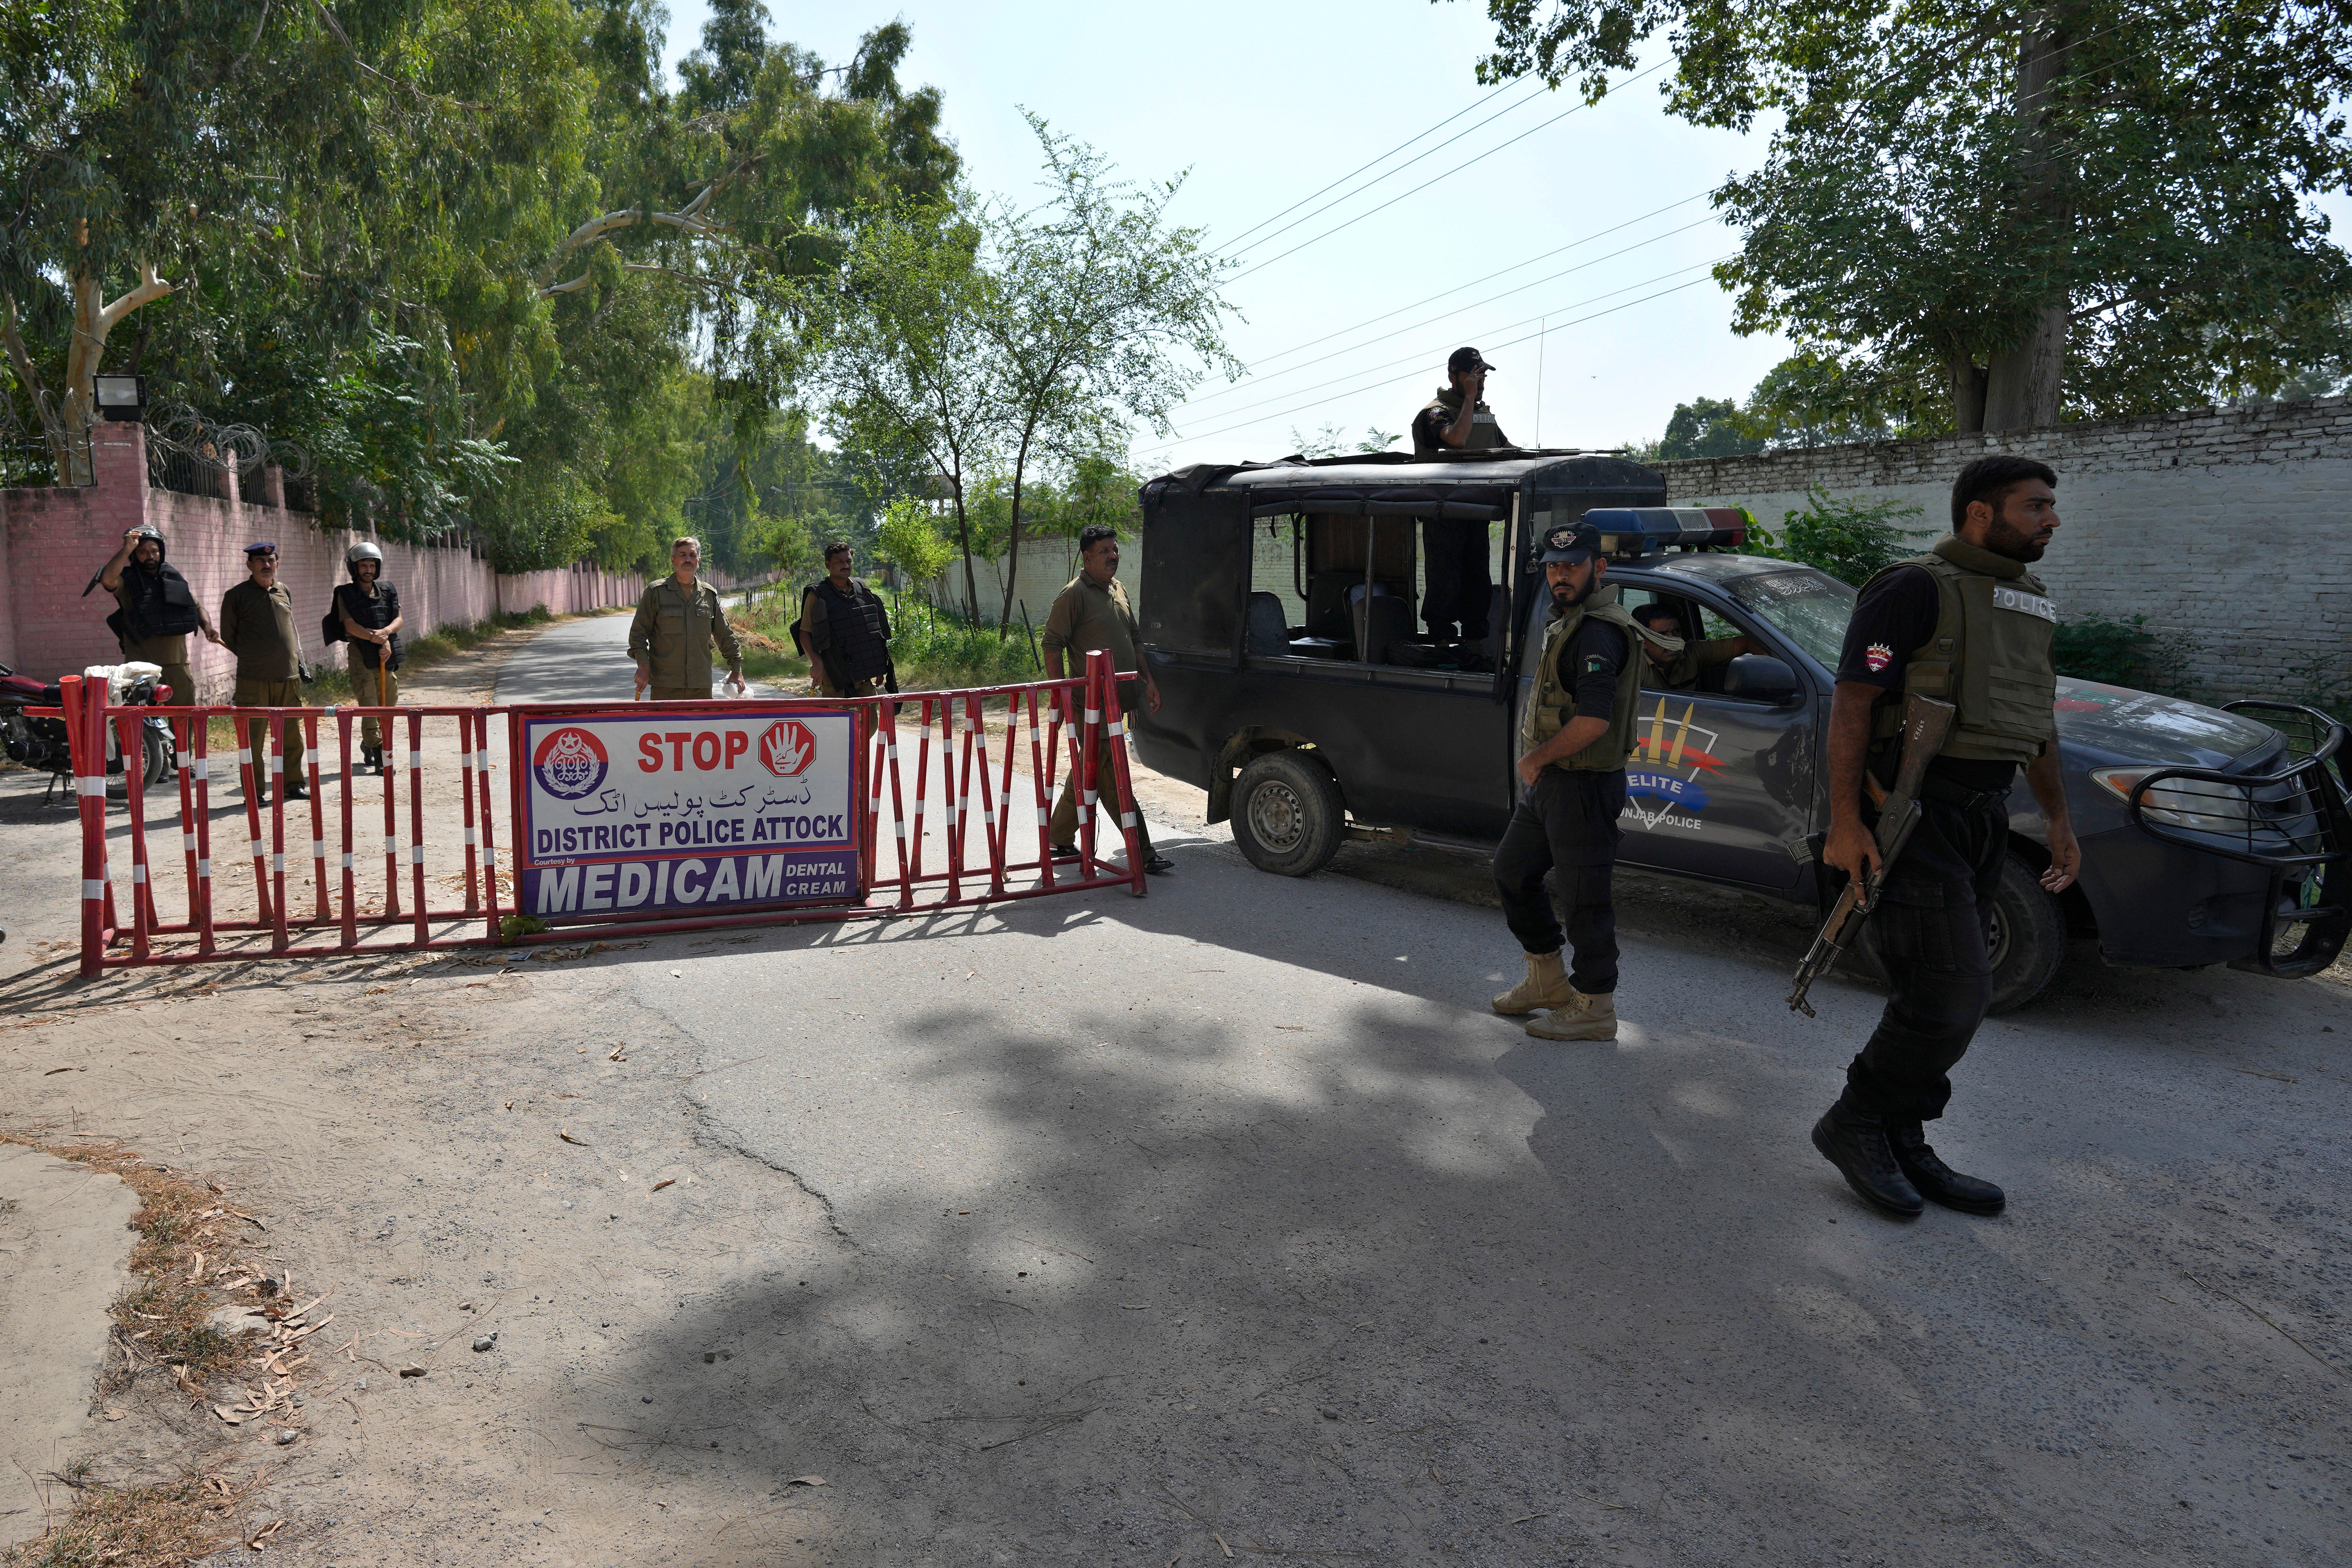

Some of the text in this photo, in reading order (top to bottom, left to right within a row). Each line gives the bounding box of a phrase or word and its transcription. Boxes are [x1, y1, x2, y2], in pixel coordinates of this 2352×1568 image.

[1473, 414, 1495, 422] OLICE
[1914, 720, 1925, 740] 23383
[638, 731, 748, 773] STOP
[1627, 774, 1683, 794] ELITE
[574, 789, 626, 815] اٹک
[634, 789, 702, 818] پولیس
[1620, 807, 1702, 830] UNJAB POLICE
[538, 815, 843, 854] DISTRICT POLICE ATTOCK
[786, 862, 846, 877] DENTAL
[537, 854, 785, 914] MEDICAM
[786, 881, 846, 896] CREAM
